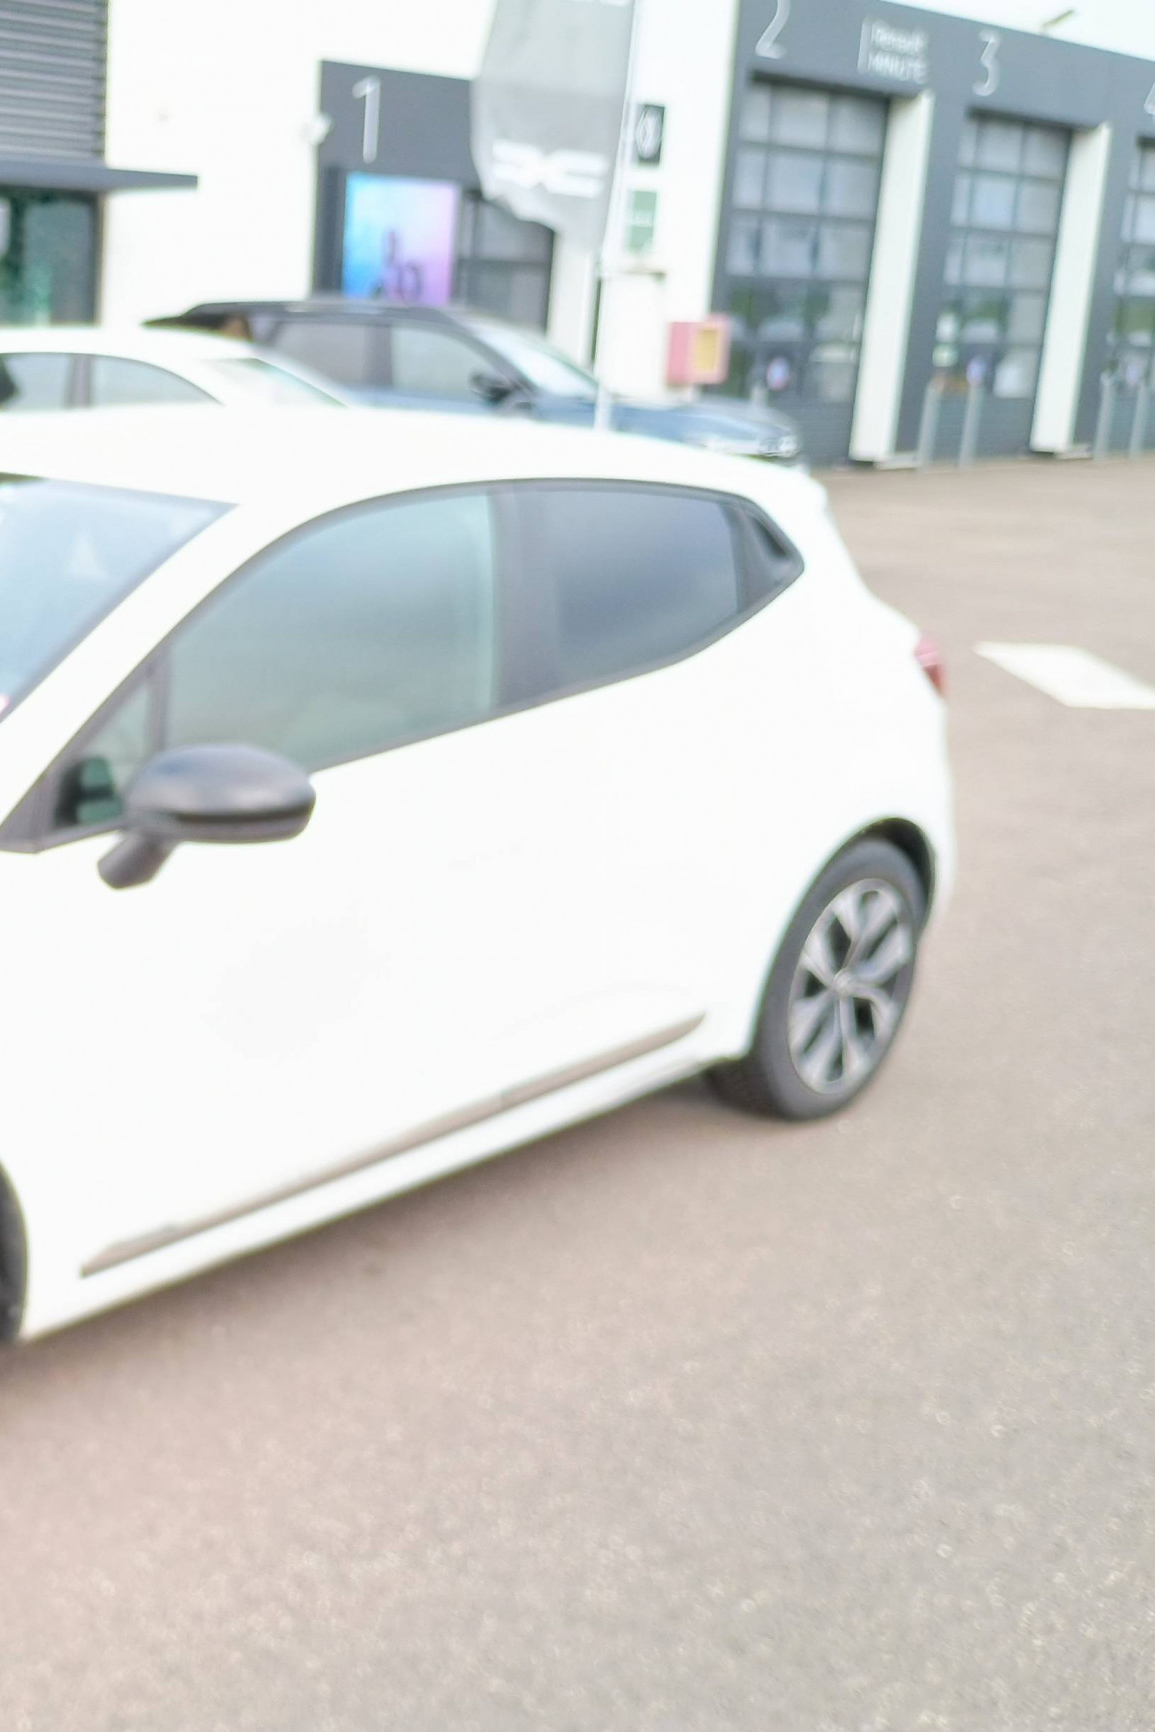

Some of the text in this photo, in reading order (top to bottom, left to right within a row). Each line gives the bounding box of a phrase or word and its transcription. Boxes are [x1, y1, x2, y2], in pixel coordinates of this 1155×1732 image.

[754, 0, 791, 60] 2
[972, 29, 1001, 96] 3
[352, 76, 380, 163] 1
